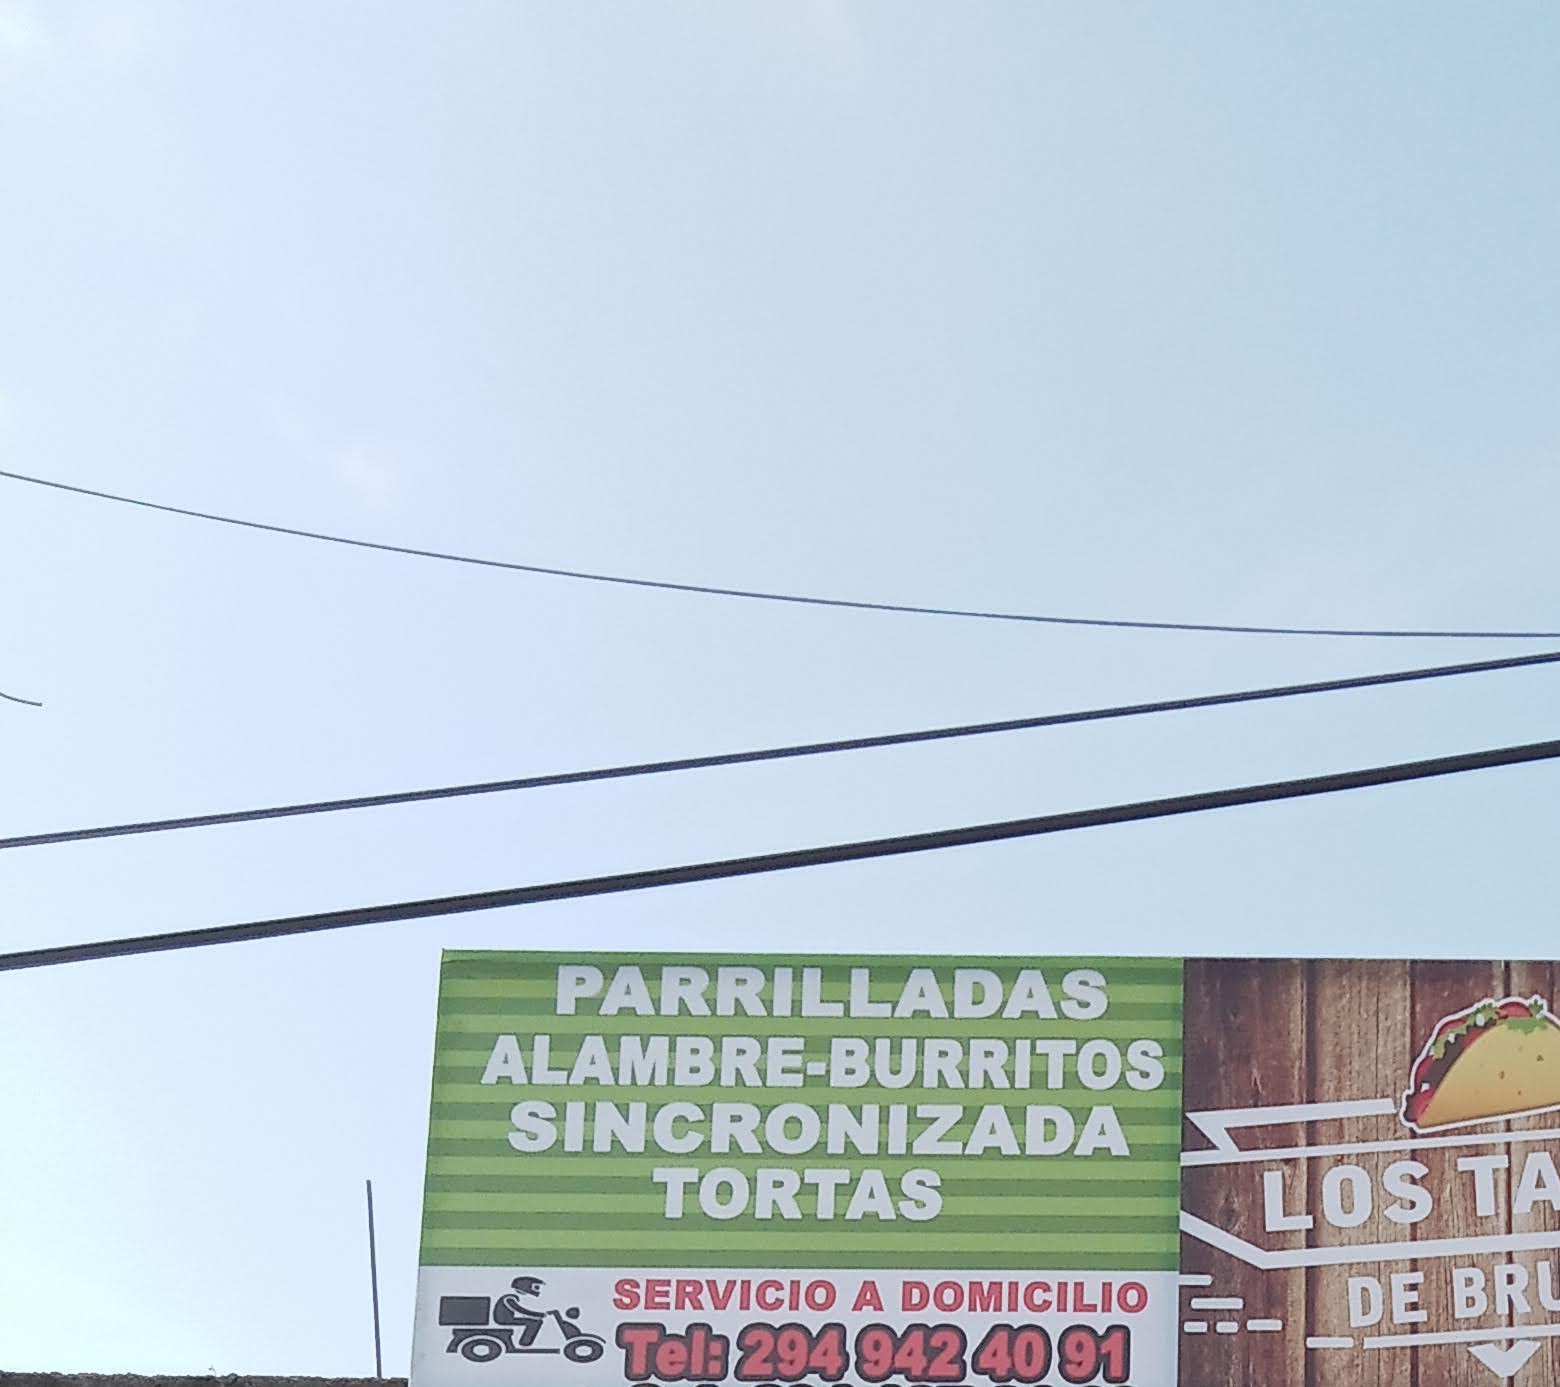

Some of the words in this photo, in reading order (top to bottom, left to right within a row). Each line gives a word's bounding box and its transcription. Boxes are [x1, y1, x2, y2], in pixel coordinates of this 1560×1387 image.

[556, 965, 1108, 1020] PARRILLADAS
[481, 1034, 1165, 1091] ALAMBRE-BURRITOS
[507, 1100, 1130, 1157] SINCRONIZADA
[653, 1168, 943, 1221] TORTAS
[1262, 1161, 1432, 1232] LOS
[613, 1279, 837, 1312] SERVICIO
[852, 1282, 884, 1312] A
[901, 1281, 1148, 1314] DOMICILIO
[1348, 1271, 1428, 1327] DE
[618, 1325, 729, 1381] Tel:
[739, 1325, 846, 1381] 294
[859, 1325, 964, 1382] 942
[975, 1326, 1049, 1381] 40
[1061, 1325, 1128, 1381] 91
